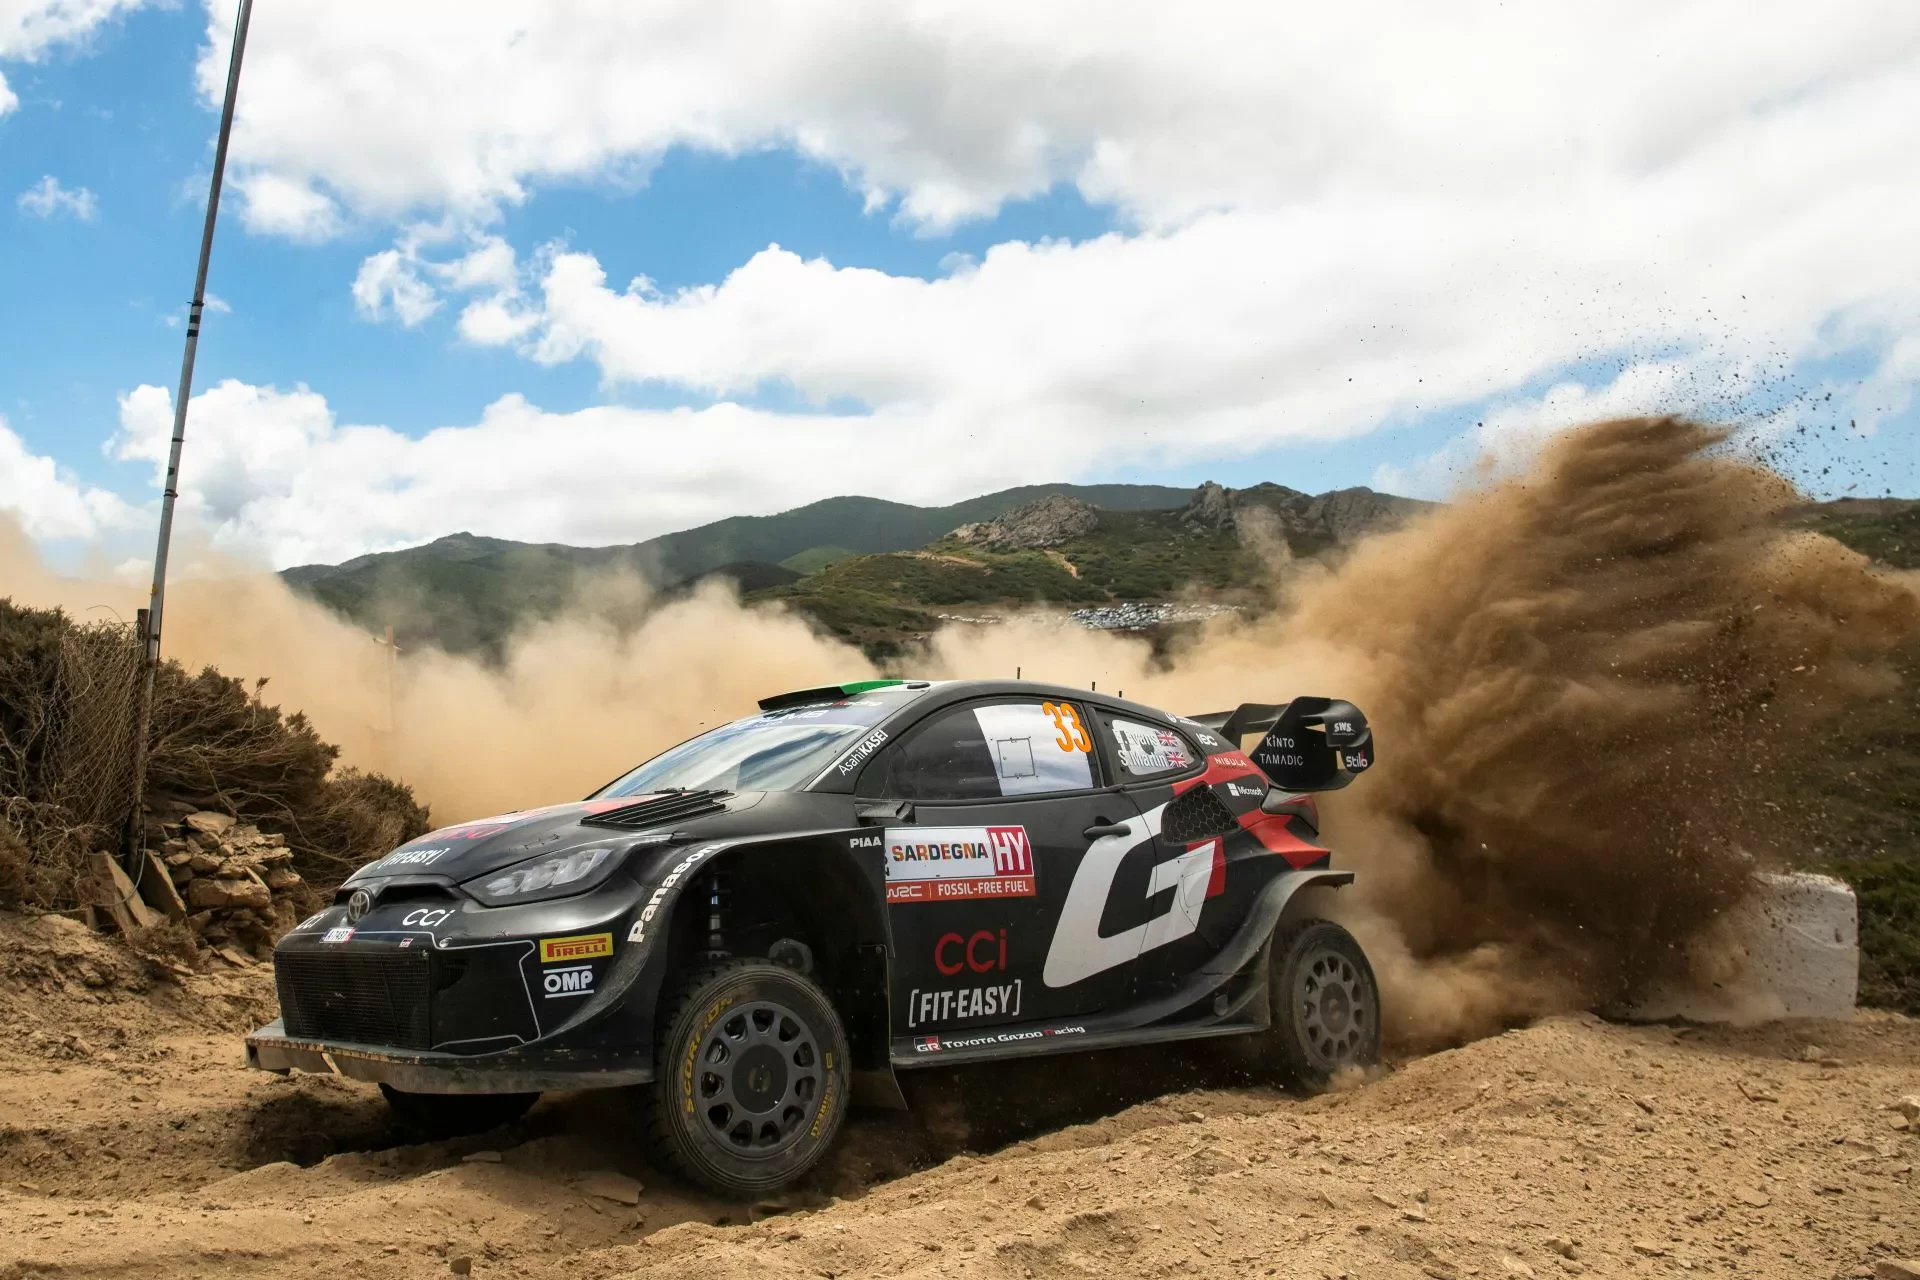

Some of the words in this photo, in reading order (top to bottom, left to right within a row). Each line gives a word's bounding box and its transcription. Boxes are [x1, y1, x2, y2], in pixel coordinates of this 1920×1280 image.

[1042, 701, 1092, 752] 33
[1334, 722, 1352, 732] SWS
[1266, 735, 1295, 748] KINTO
[838, 729, 889, 776] AsahiKASEI
[1260, 753, 1304, 766] TAMADIC
[1346, 751, 1367, 767] Stilo
[1215, 757, 1247, 766] NISULA
[850, 837, 882, 849] PIAA
[991, 832, 1025, 870] HY
[891, 843, 988, 861] SARDEGNA
[938, 882, 1003, 896] FOSSIL-FREE
[1005, 880, 1029, 893] FUEL
[547, 937, 607, 957] PIRELLI
[544, 970, 593, 992] OMP
